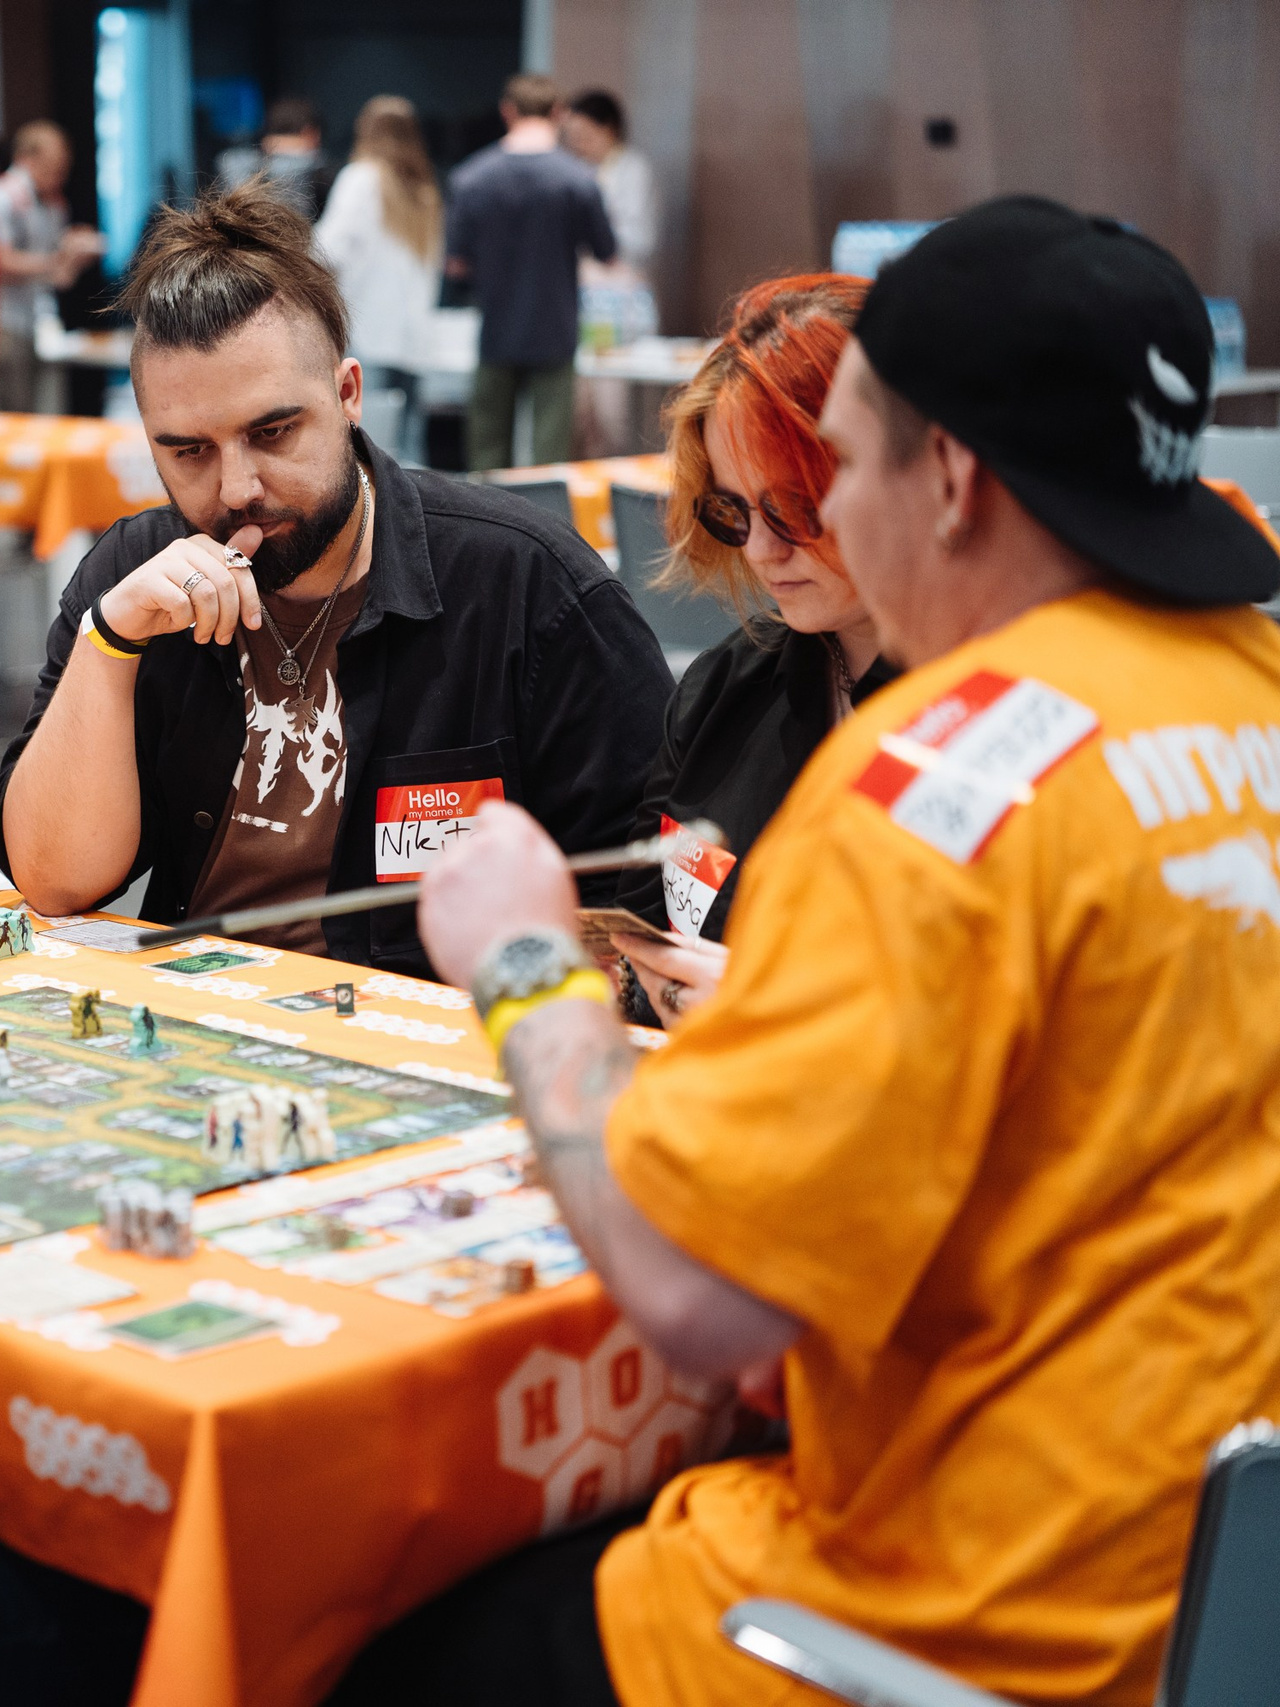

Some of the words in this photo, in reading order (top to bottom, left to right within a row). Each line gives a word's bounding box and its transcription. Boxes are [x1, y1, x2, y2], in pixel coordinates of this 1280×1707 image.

[1103, 725, 1280, 829] ИГРО
[408, 789, 460, 808] Hello
[409, 810, 422, 819] my
[425, 808, 453, 817] name
[456, 807, 463, 815] is
[381, 814, 473, 859] Nikit
